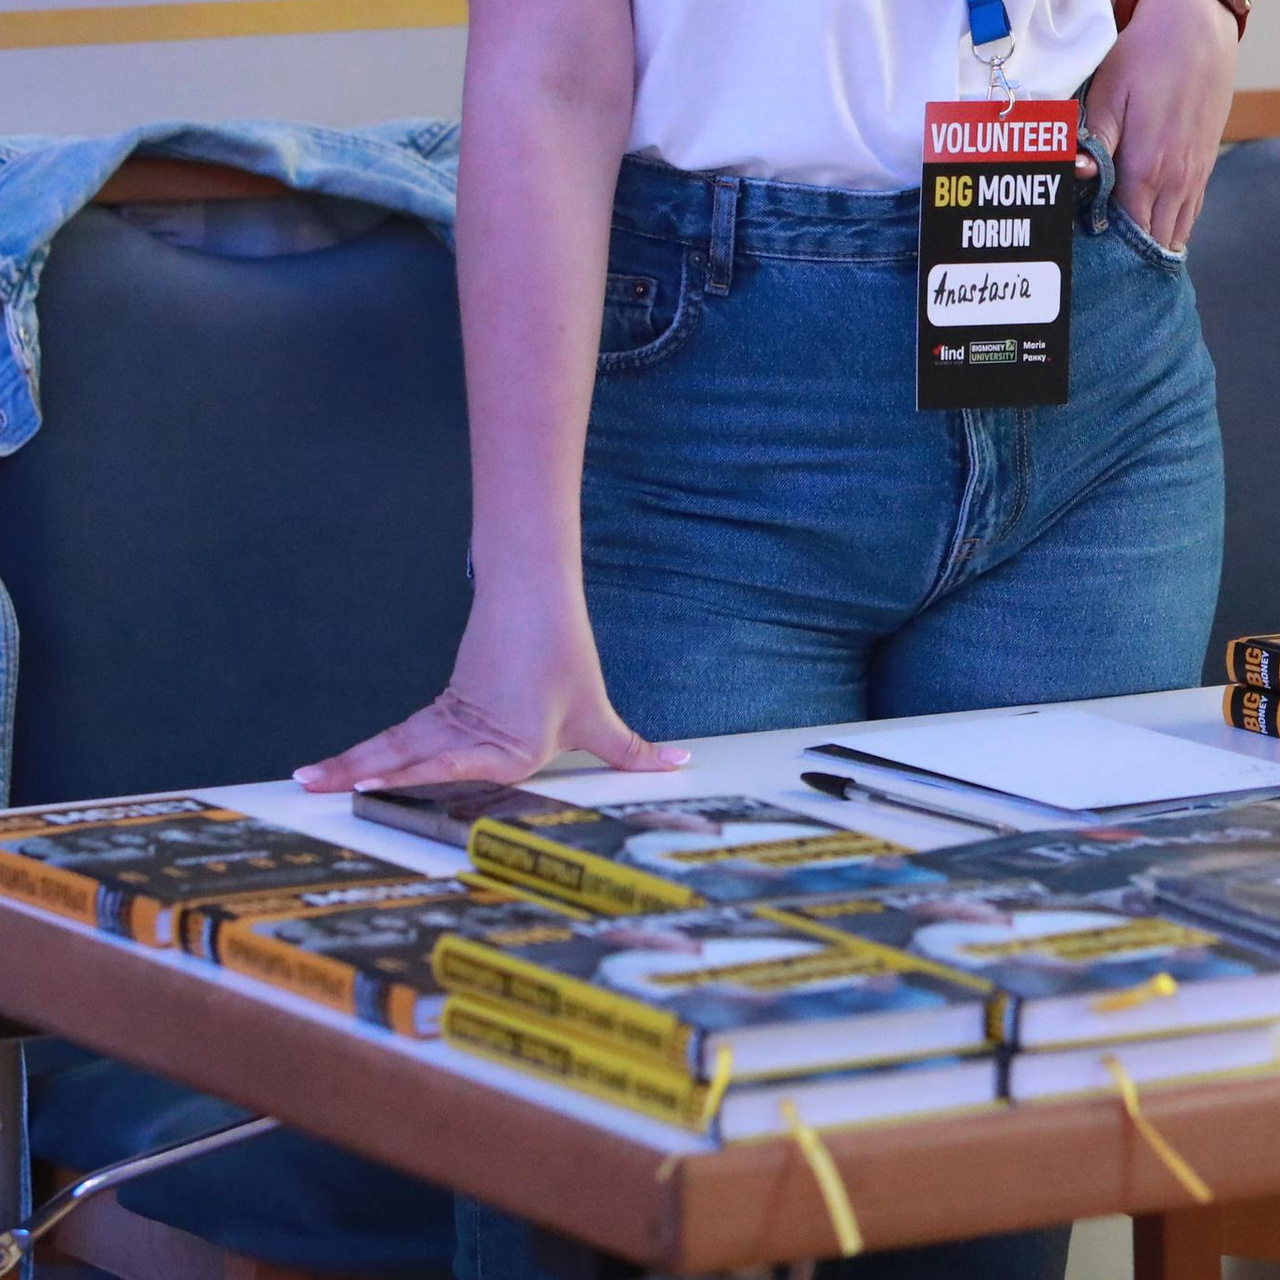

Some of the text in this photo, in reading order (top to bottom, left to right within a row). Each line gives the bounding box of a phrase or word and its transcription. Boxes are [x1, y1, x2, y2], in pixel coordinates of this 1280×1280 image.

[931, 121, 1068, 153] VOLUNTEER
[934, 174, 1061, 207] BIG MONEY
[962, 219, 1031, 248] FORUM
[933, 271, 1032, 306] Anastasia
[971, 344, 1005, 352] BIGMONEY
[971, 352, 1015, 361] UNIVERSITY
[1245, 647, 1263, 687] BIG
[1260, 650, 1271, 689] MONEY
[1243, 692, 1261, 732] BIG
[1257, 695, 1269, 734] MONEY
